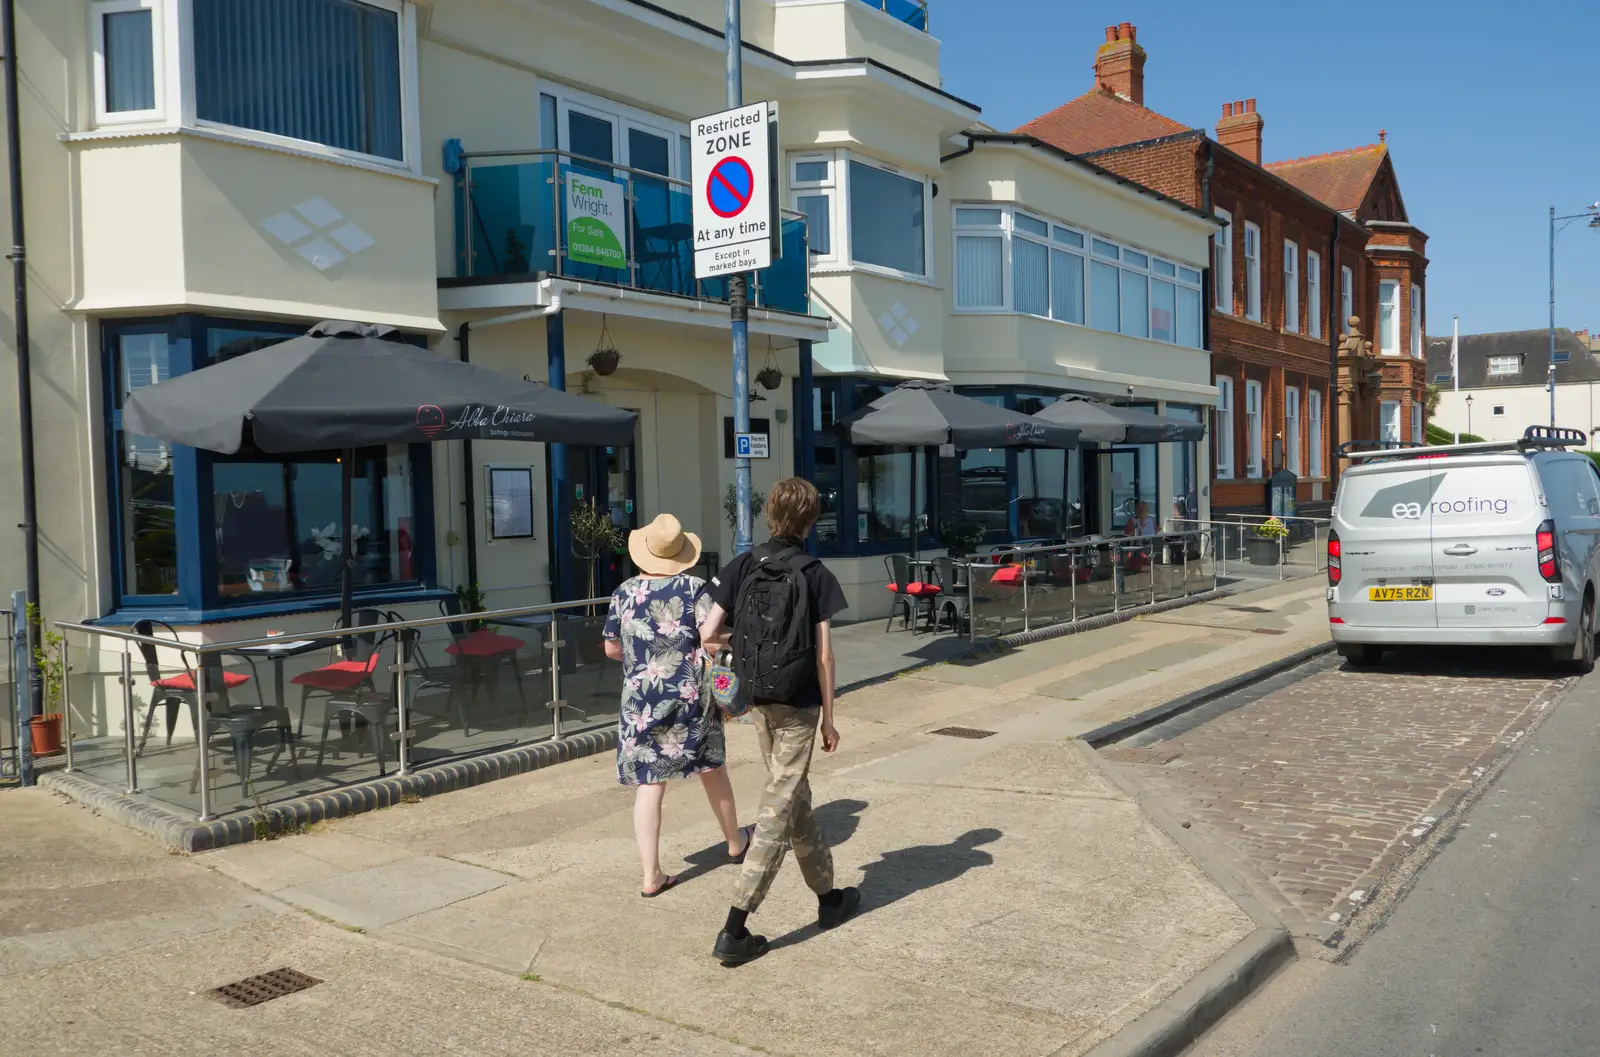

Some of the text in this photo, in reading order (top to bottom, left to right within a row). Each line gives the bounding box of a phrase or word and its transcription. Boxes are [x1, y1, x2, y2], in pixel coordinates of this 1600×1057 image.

[697, 109, 761, 137] Restricted
[706, 130, 752, 155] ZONE
[571, 179, 603, 200] Fenn
[572, 222, 604, 237] For Sale
[697, 220, 767, 243] At any time
[572, 242, 594, 254] 01394
[595, 248, 621, 259] 548700
[715, 247, 750, 262] Except in
[709, 257, 757, 273] marked bays
[740, 439, 748, 453] P
[1391, 497, 1508, 519] ea roofing
[1374, 588, 1430, 599] AV75 RZN
